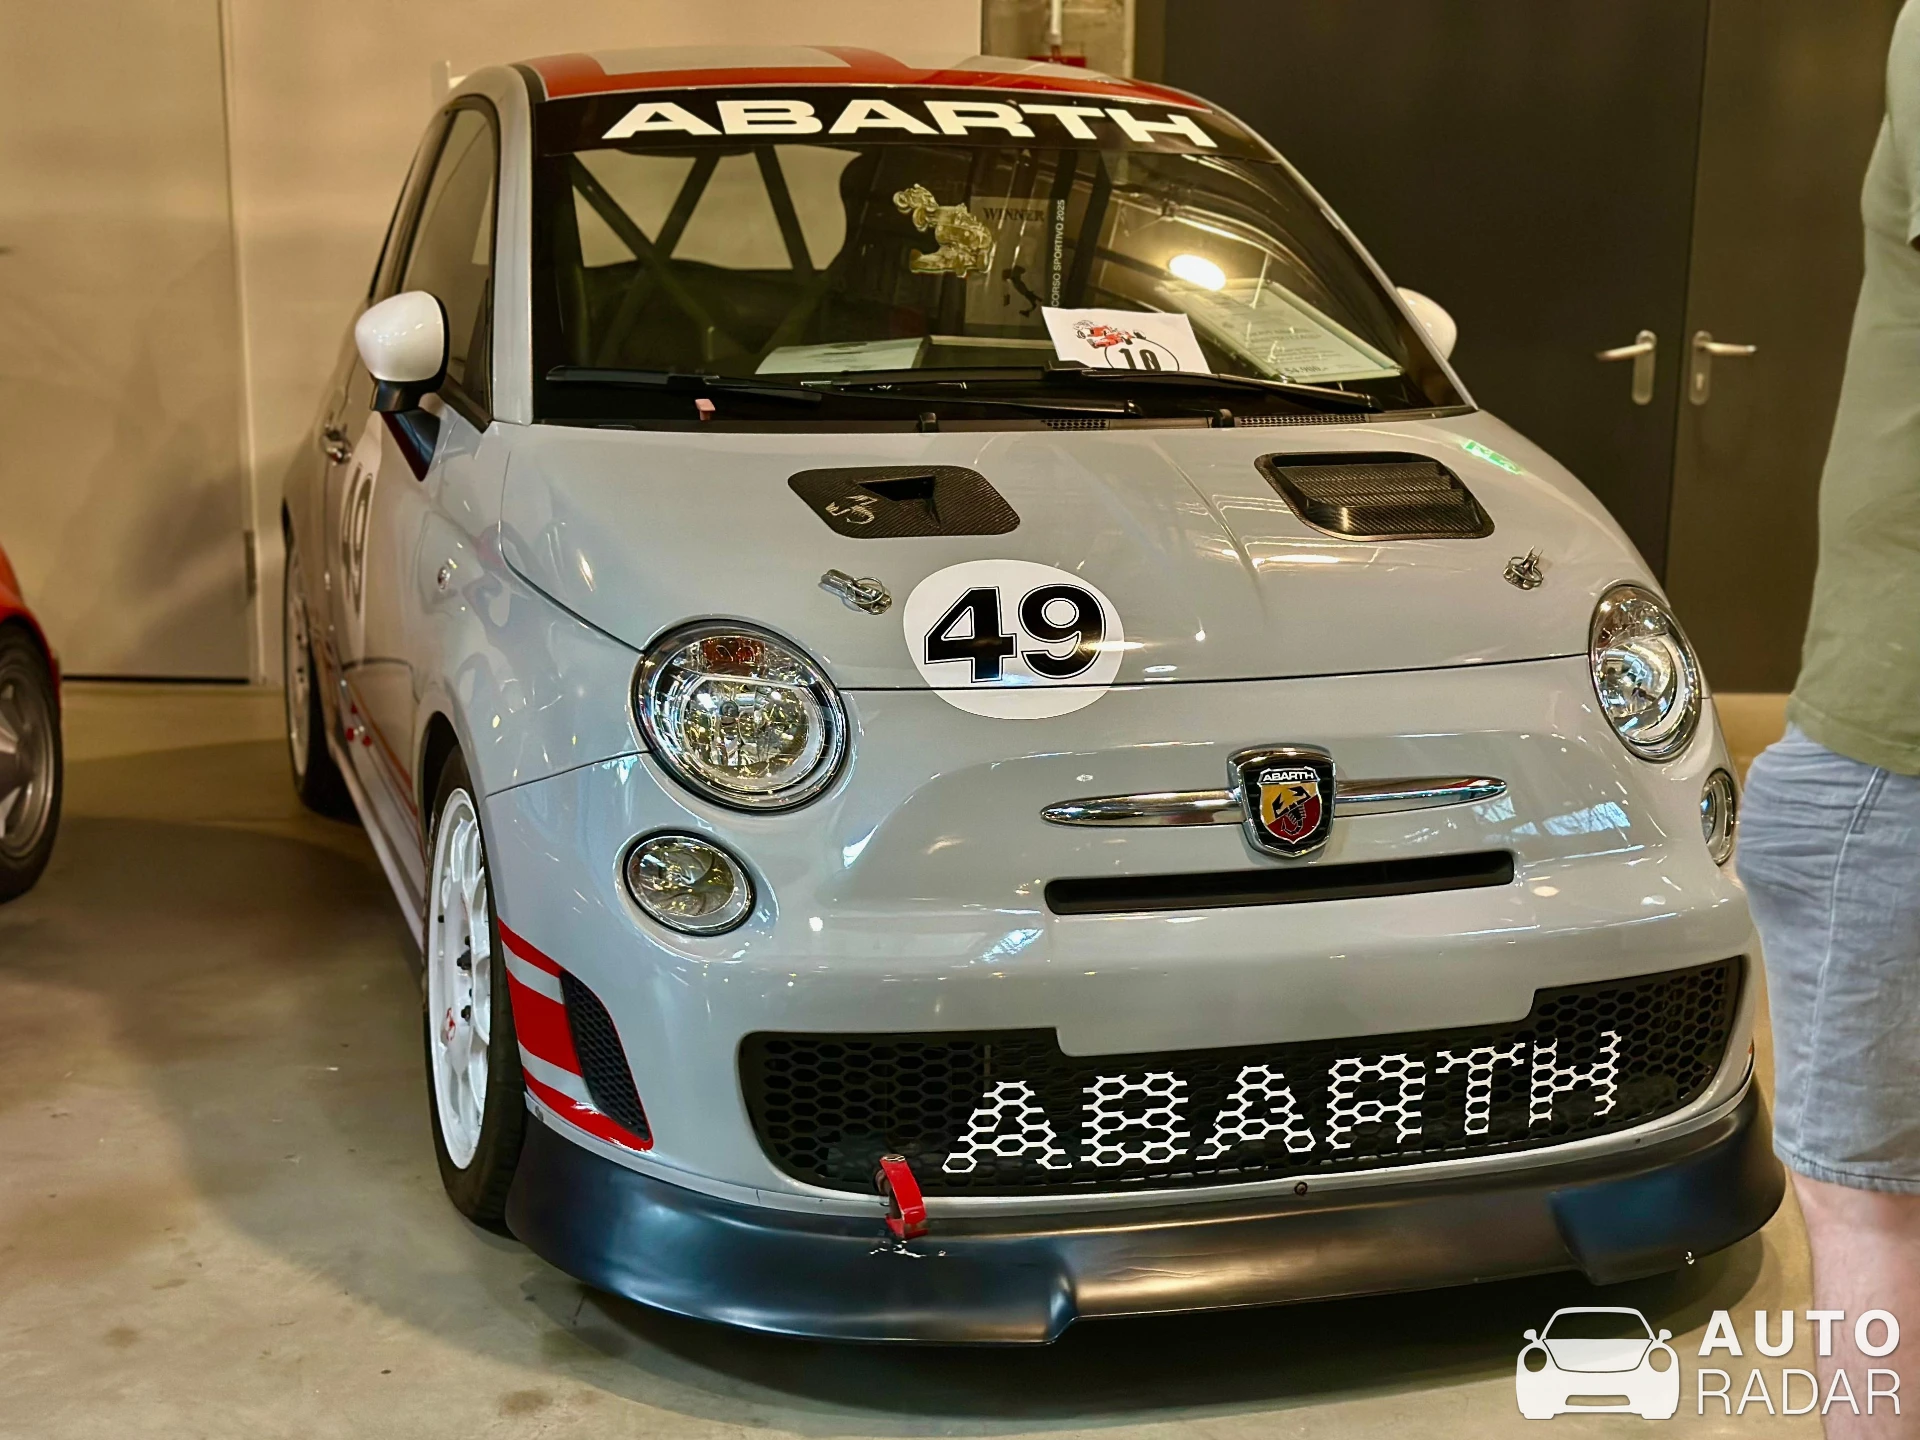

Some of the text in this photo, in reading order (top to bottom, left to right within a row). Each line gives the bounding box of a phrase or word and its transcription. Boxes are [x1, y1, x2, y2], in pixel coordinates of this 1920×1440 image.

[602, 99, 1219, 149] ABARTH
[984, 208, 1044, 221] WINNER
[1057, 200, 1065, 221] 2025
[1054, 223, 1063, 271] SPORTIVO
[924, 583, 1106, 683] 49
[1262, 771, 1315, 782] ABARTH
[942, 1030, 1623, 1173] ABARTH
